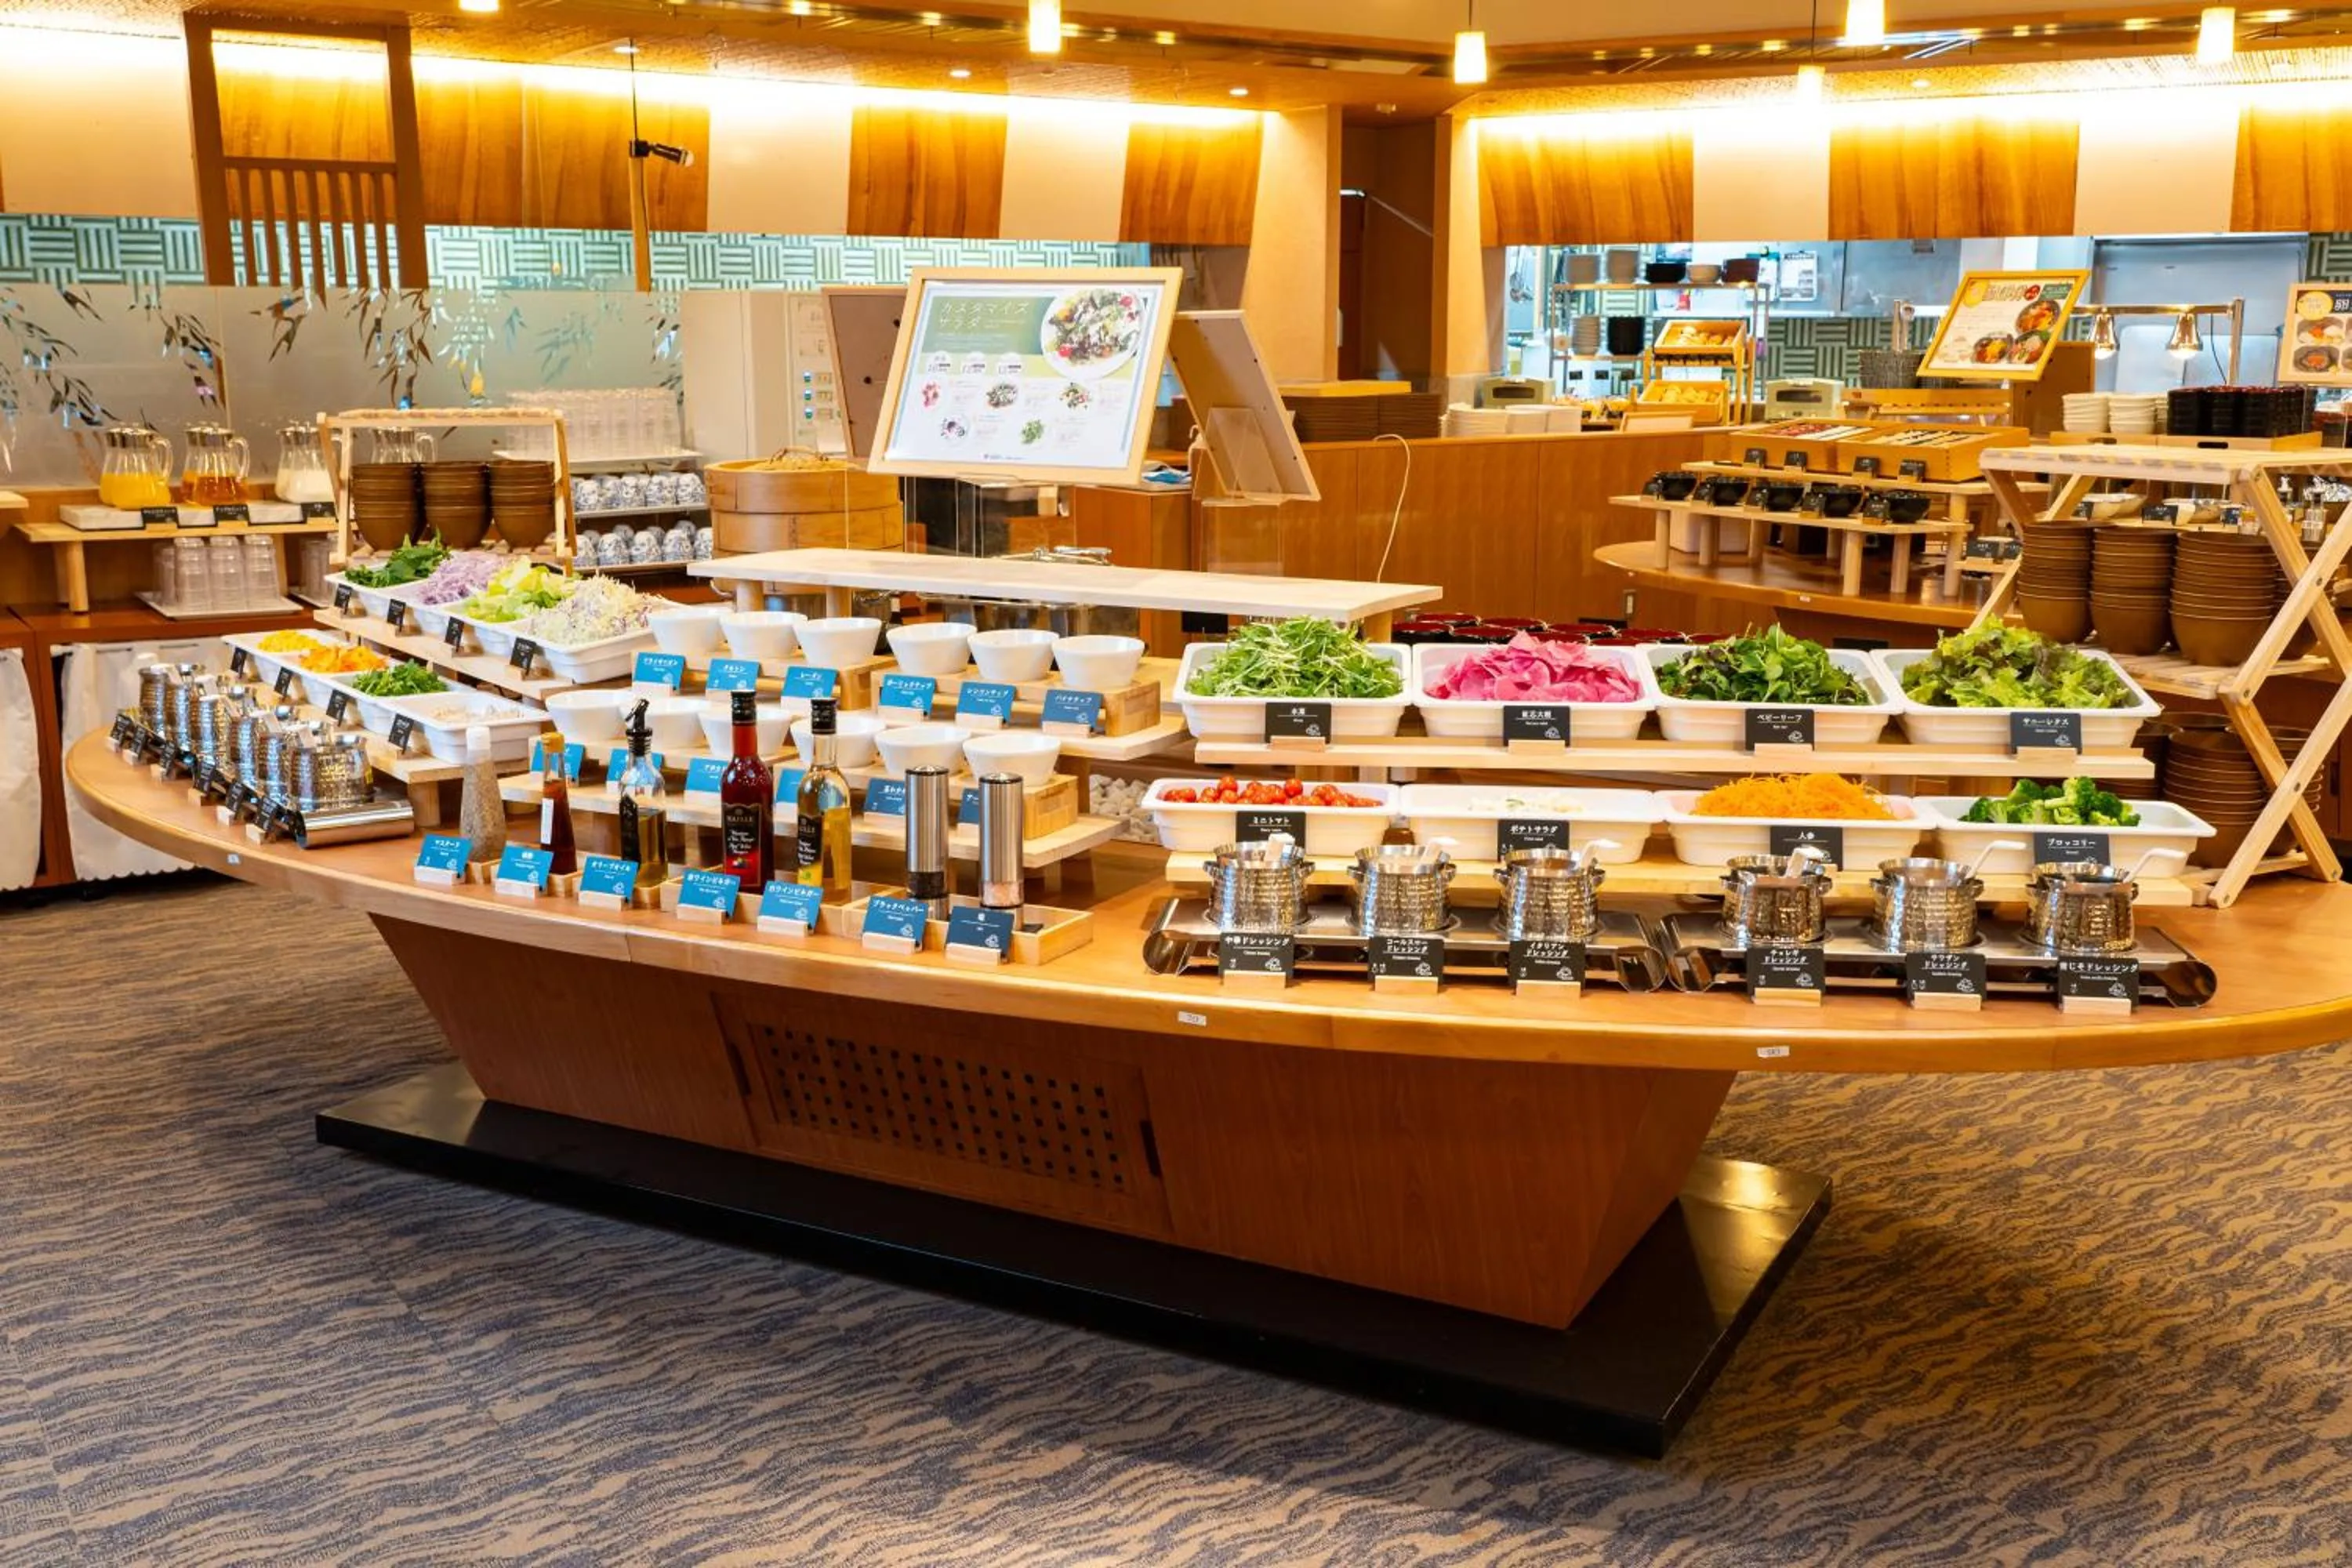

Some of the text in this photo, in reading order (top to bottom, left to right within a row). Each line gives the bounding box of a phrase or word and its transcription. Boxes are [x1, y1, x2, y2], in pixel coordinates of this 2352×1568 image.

[940, 300, 1030, 314] カスタマイズ
[939, 315, 982, 330] サラダ
[887, 678, 932, 689] ガーリックチップ
[1522, 710, 1552, 719] 紅芯大根
[2023, 717, 2069, 726] サニーレタス
[1511, 824, 1559, 833] ポテトサラダ
[1798, 831, 1815, 840] 人参
[434, 840, 461, 848] マスタード
[2047, 837, 2096, 847] ブロッコリー
[592, 860, 631, 873] オリーブオイル
[768, 884, 821, 898] 白ワインビネガー
[873, 900, 924, 913] ブラックペッパー
[1225, 935, 1290, 947] 中華ドレッシング
[1386, 946, 1428, 954] ドレッシング
[1764, 956, 1808, 964] ドレッシング
[1925, 960, 1968, 969] ドレッシング
[2059, 961, 2139, 973] 青じそドレッシング
